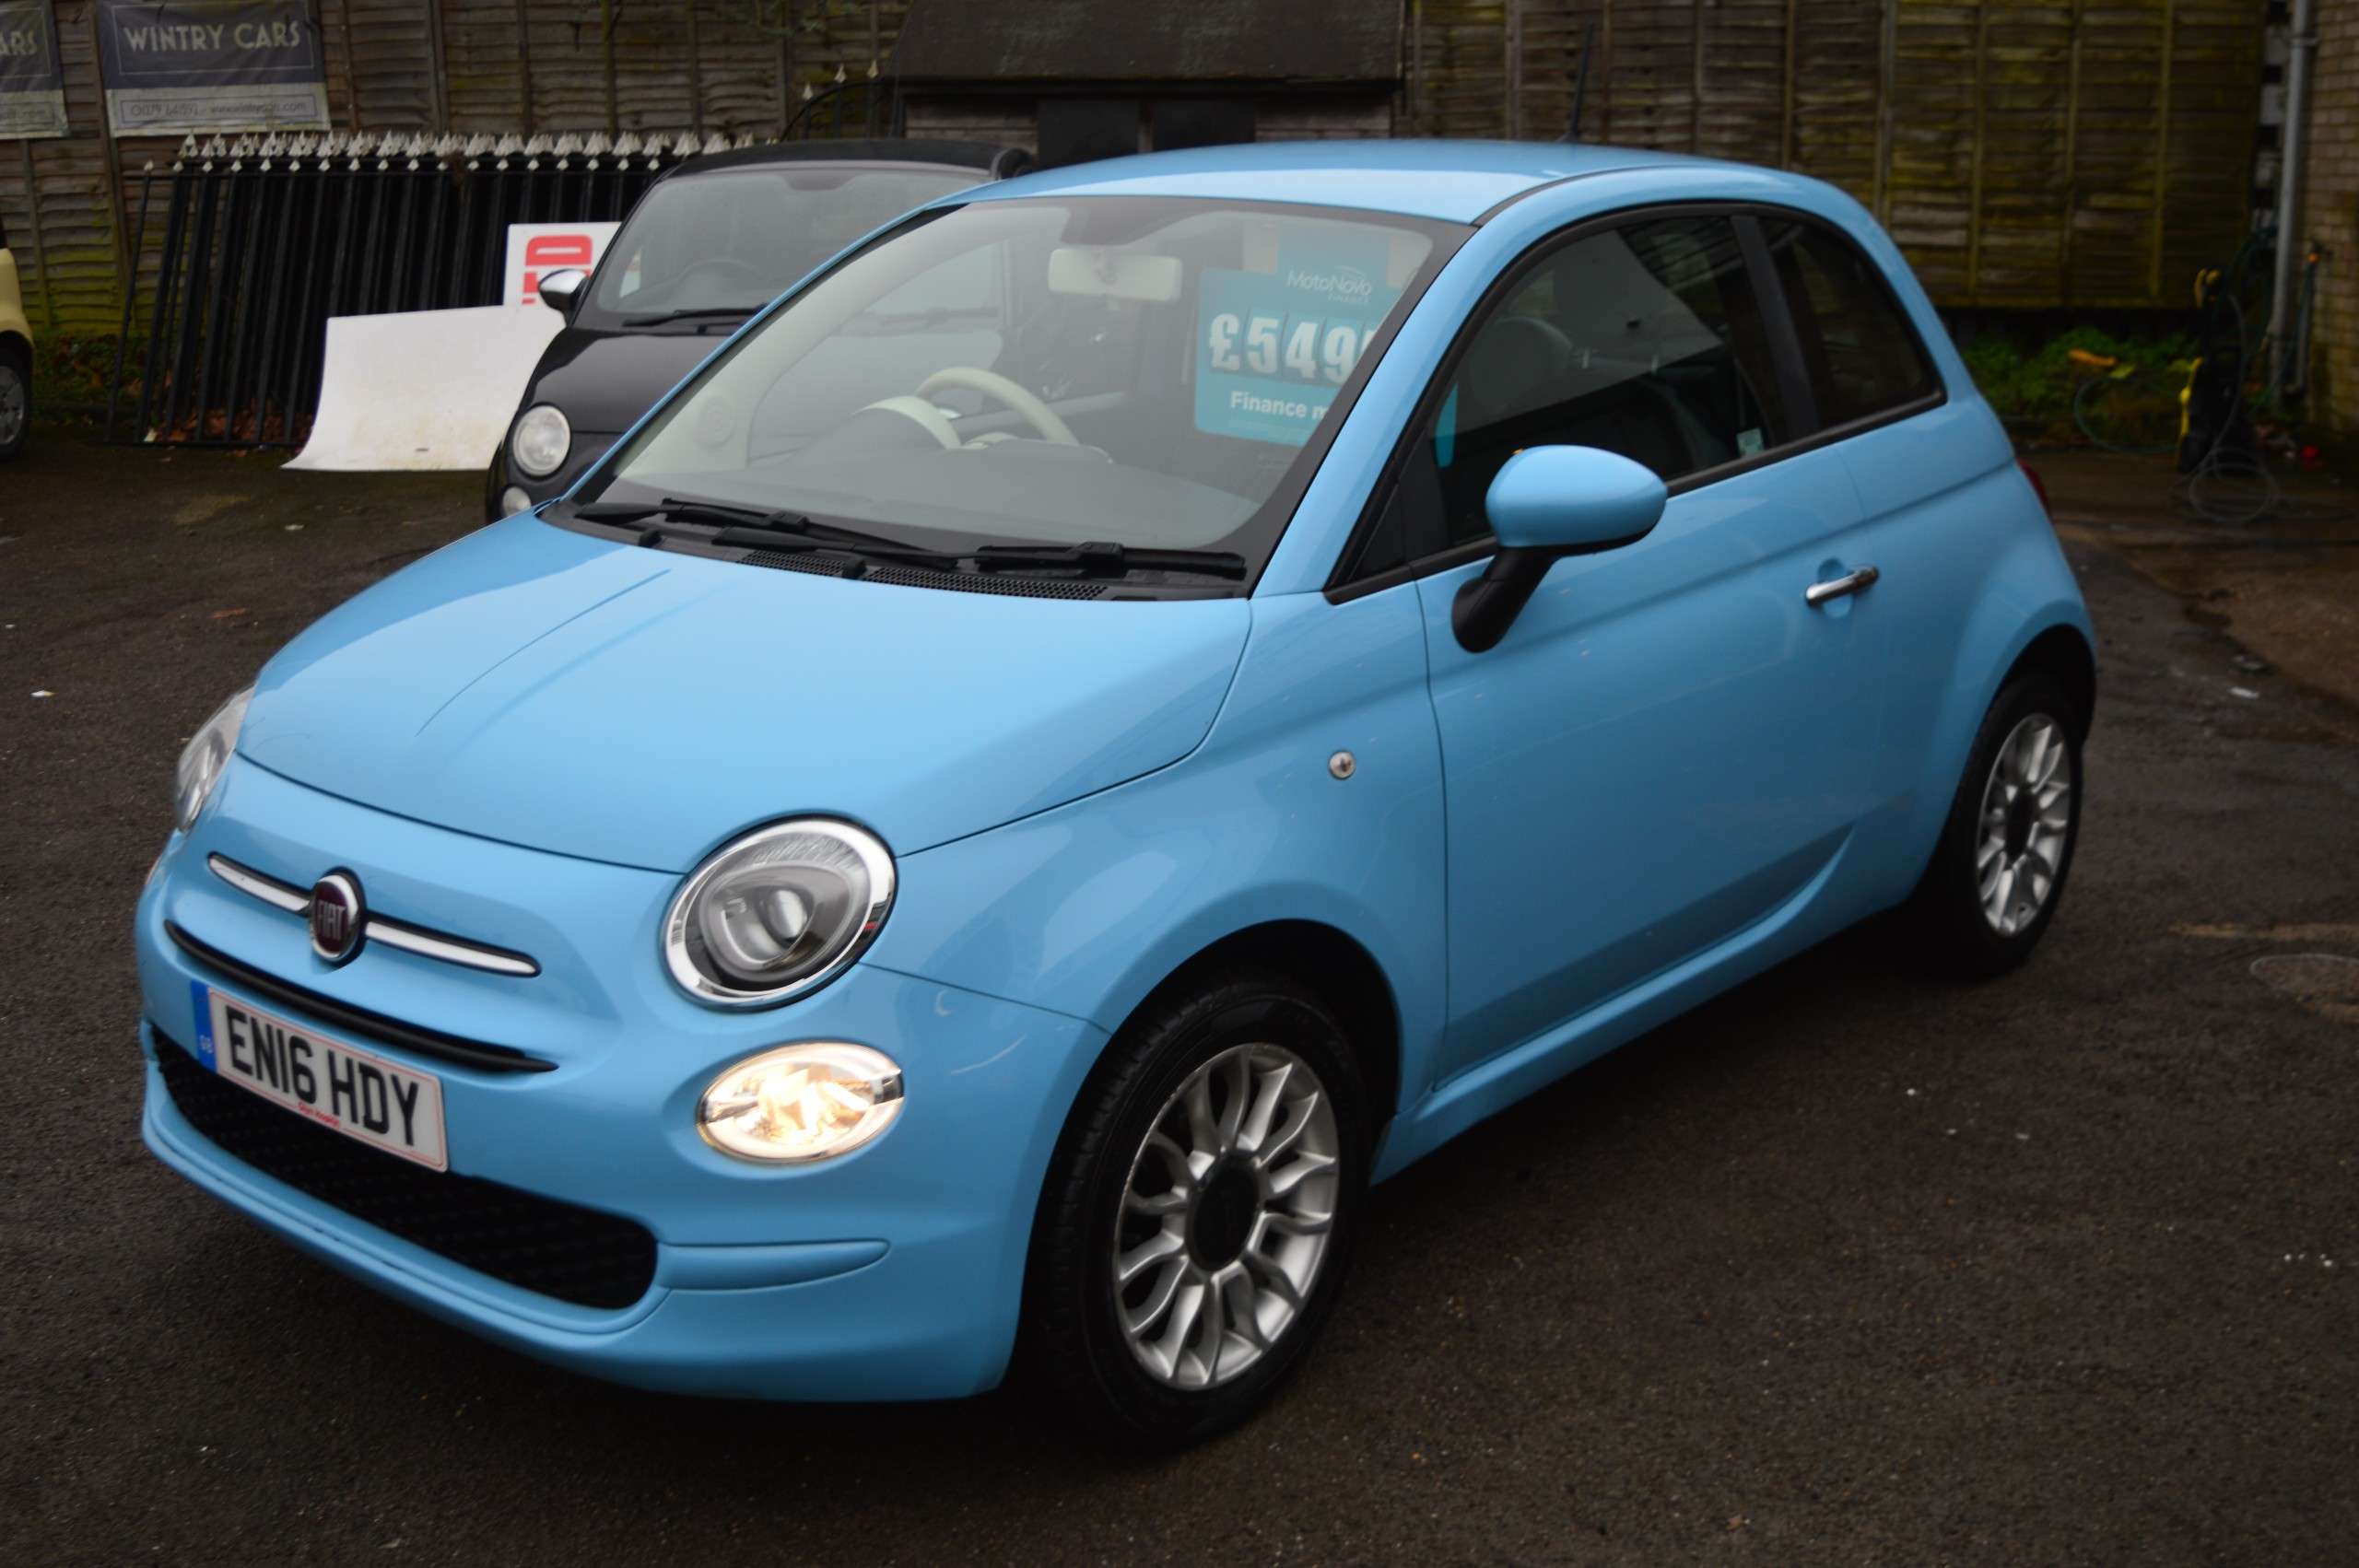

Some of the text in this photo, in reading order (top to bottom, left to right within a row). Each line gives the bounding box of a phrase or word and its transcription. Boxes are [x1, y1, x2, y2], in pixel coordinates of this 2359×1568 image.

[123, 20, 301, 53] WINTRY CARS
[1285, 270, 1372, 296] MotoNovo
[1209, 312, 1376, 384] £549
[1230, 391, 1307, 417] Finance
[318, 899, 346, 941] FIAT
[224, 1004, 418, 1146] EN16 HDY
